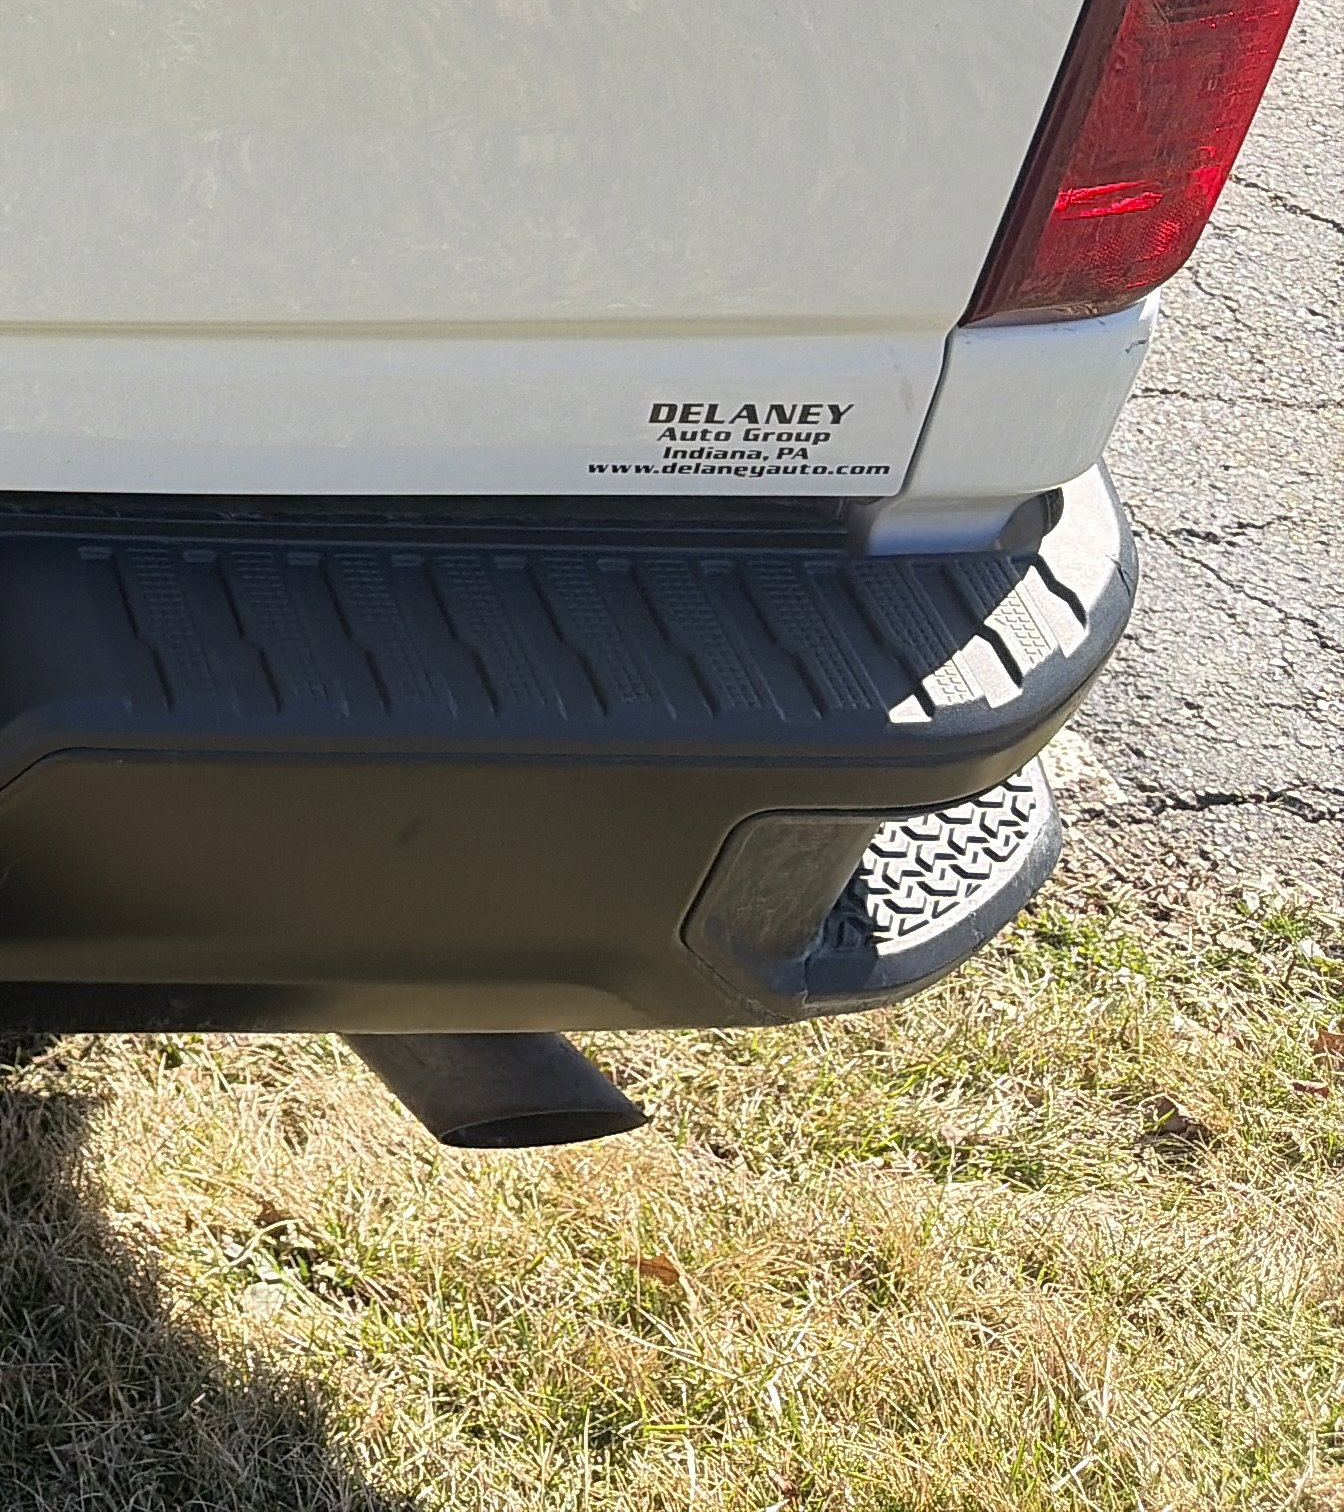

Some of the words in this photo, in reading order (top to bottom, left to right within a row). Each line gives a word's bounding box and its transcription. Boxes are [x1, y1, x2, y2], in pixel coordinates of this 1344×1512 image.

[648, 403, 855, 424] DELANEY
[657, 427, 731, 442] Auto
[741, 428, 831, 445] Group
[662, 447, 770, 462] Indiana,
[776, 447, 810, 460] PA
[588, 462, 891, 478] www.delaneyauto.com
